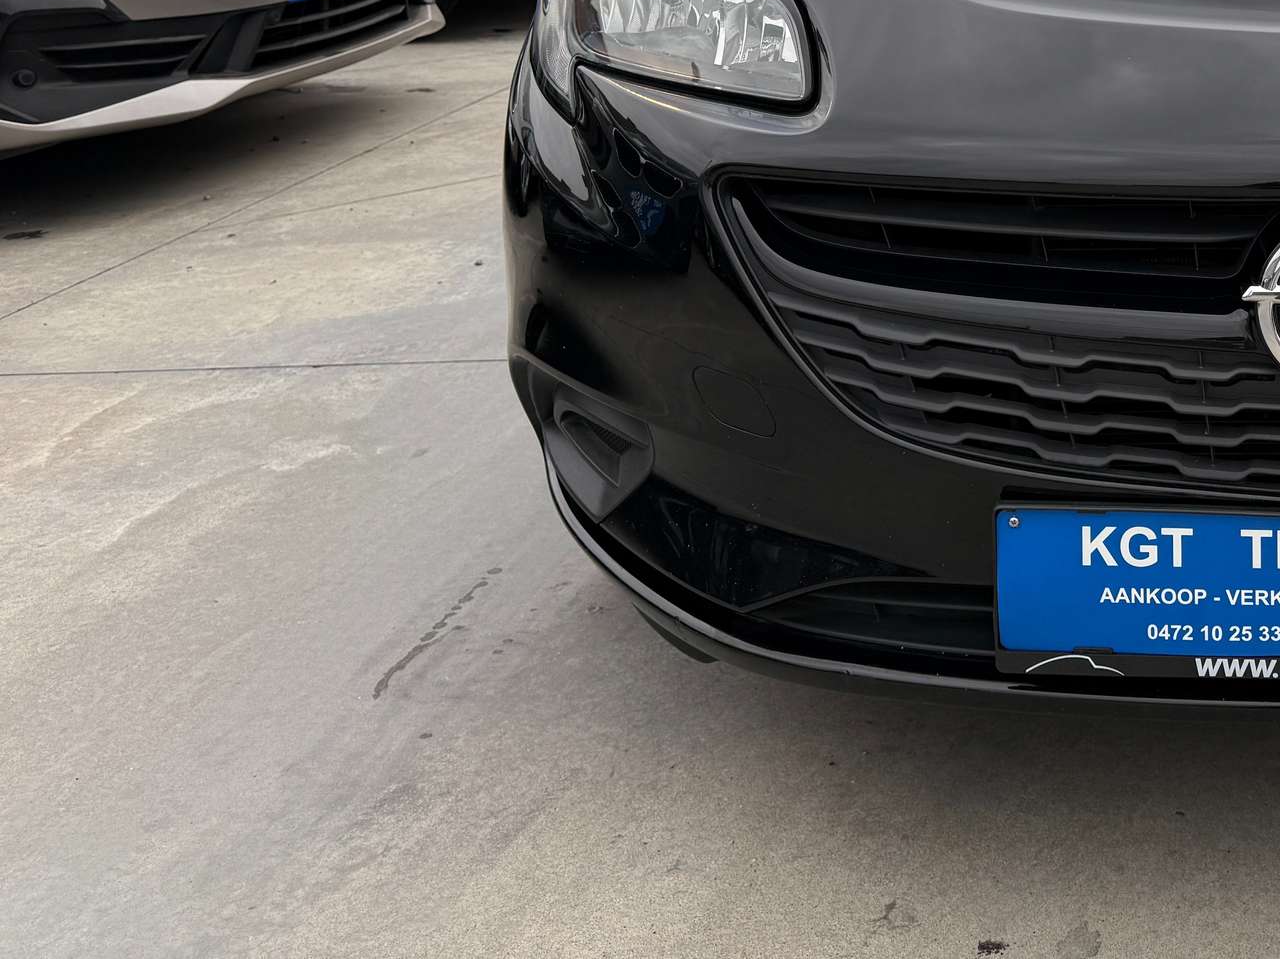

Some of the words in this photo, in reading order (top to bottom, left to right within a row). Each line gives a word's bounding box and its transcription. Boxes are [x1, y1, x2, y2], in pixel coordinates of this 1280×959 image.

[1081, 526, 1194, 568] KGT
[1099, 588, 1207, 606] AANKOOP
[1147, 624, 1194, 641] 0472
[1200, 625, 1223, 641] 10
[1229, 625, 1253, 642] 25
